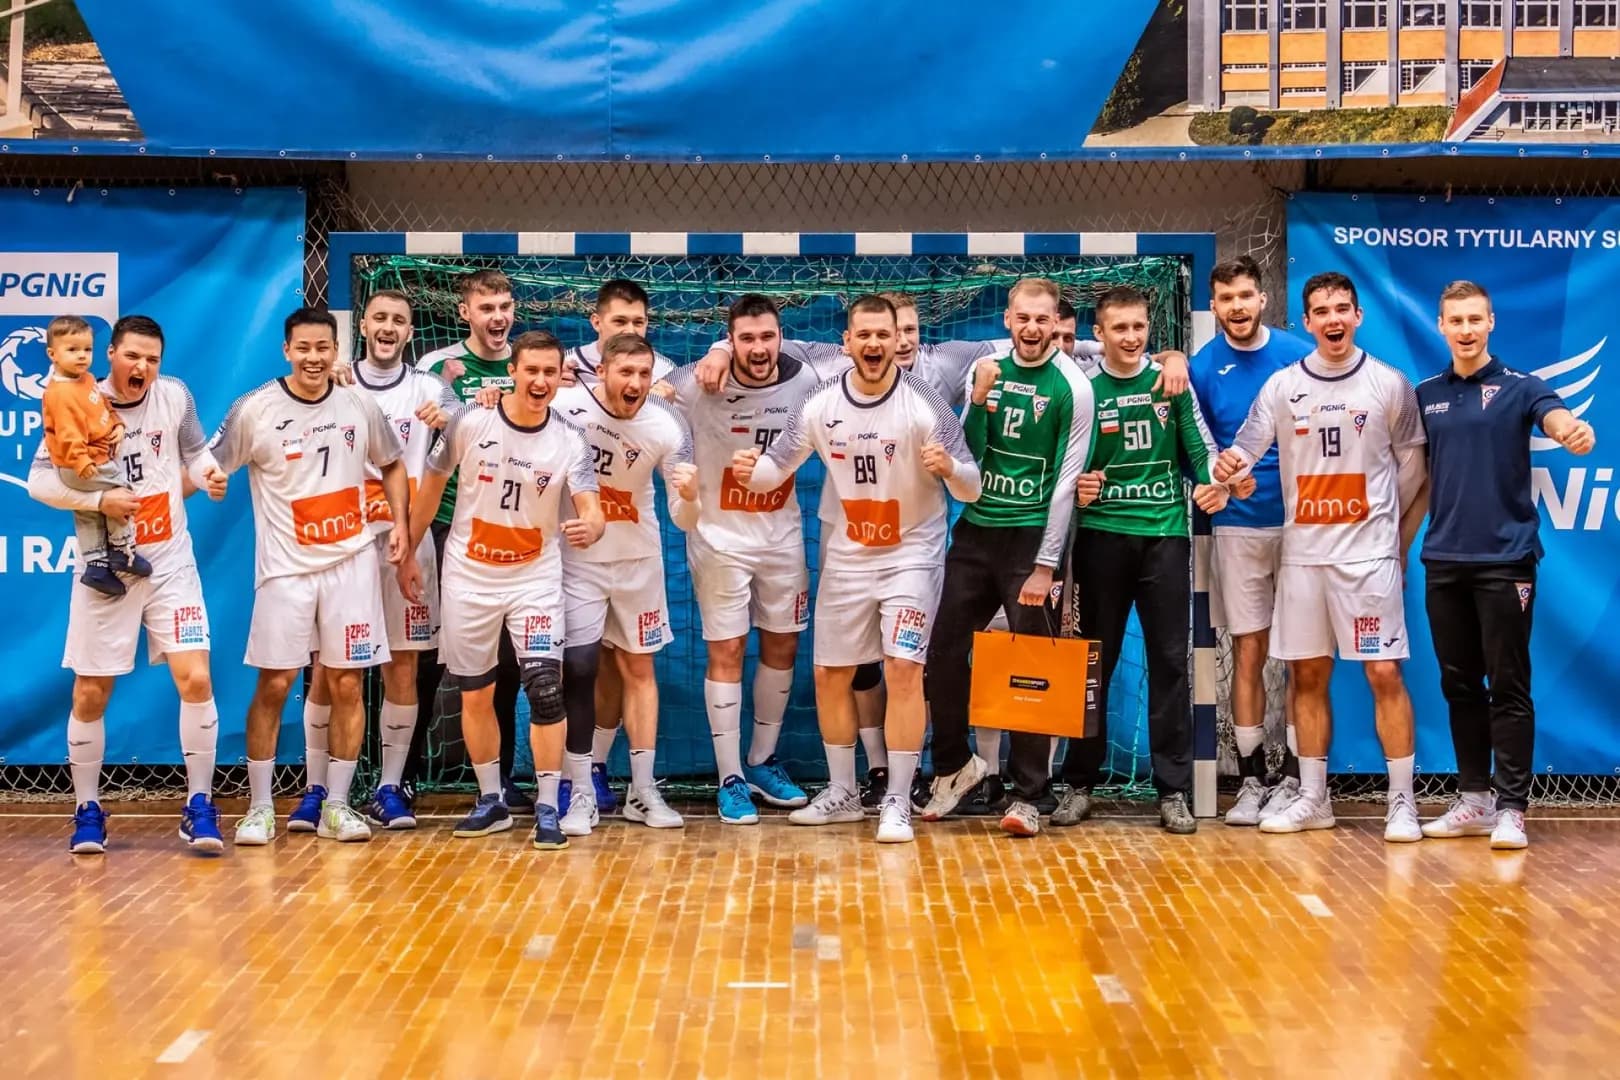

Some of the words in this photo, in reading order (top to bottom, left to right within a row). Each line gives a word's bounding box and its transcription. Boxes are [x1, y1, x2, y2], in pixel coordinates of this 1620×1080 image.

[1334, 227, 1448, 248] SPONSOR
[1455, 229, 1596, 249] TYTULARNY
[1602, 230, 1620, 249] S
[0, 273, 106, 297] PGNiG
[1321, 403, 1346, 412] PGNiG
[1003, 406, 1025, 439] 12
[1124, 420, 1152, 450] 50
[1319, 427, 1341, 457] 19
[123, 453, 144, 482] 15
[318, 445, 330, 477] 7
[590, 444, 613, 476] 22
[854, 455, 877, 484] 89
[982, 470, 1034, 497] nmc
[1107, 481, 1167, 498] nmc
[500, 480, 522, 512] 21
[728, 488, 783, 506] nmc
[1300, 498, 1362, 517] nmc
[1531, 467, 1620, 531] Ni
[304, 512, 355, 541] nmc
[847, 522, 892, 541] nmc
[474, 543, 524, 561] nm
[180, 606, 202, 621] ZPEC
[530, 616, 552, 630] ZPEC
[902, 609, 926, 628] ZPEC
[1359, 617, 1380, 632] ZPEC
[351, 623, 370, 639] ZPEC
